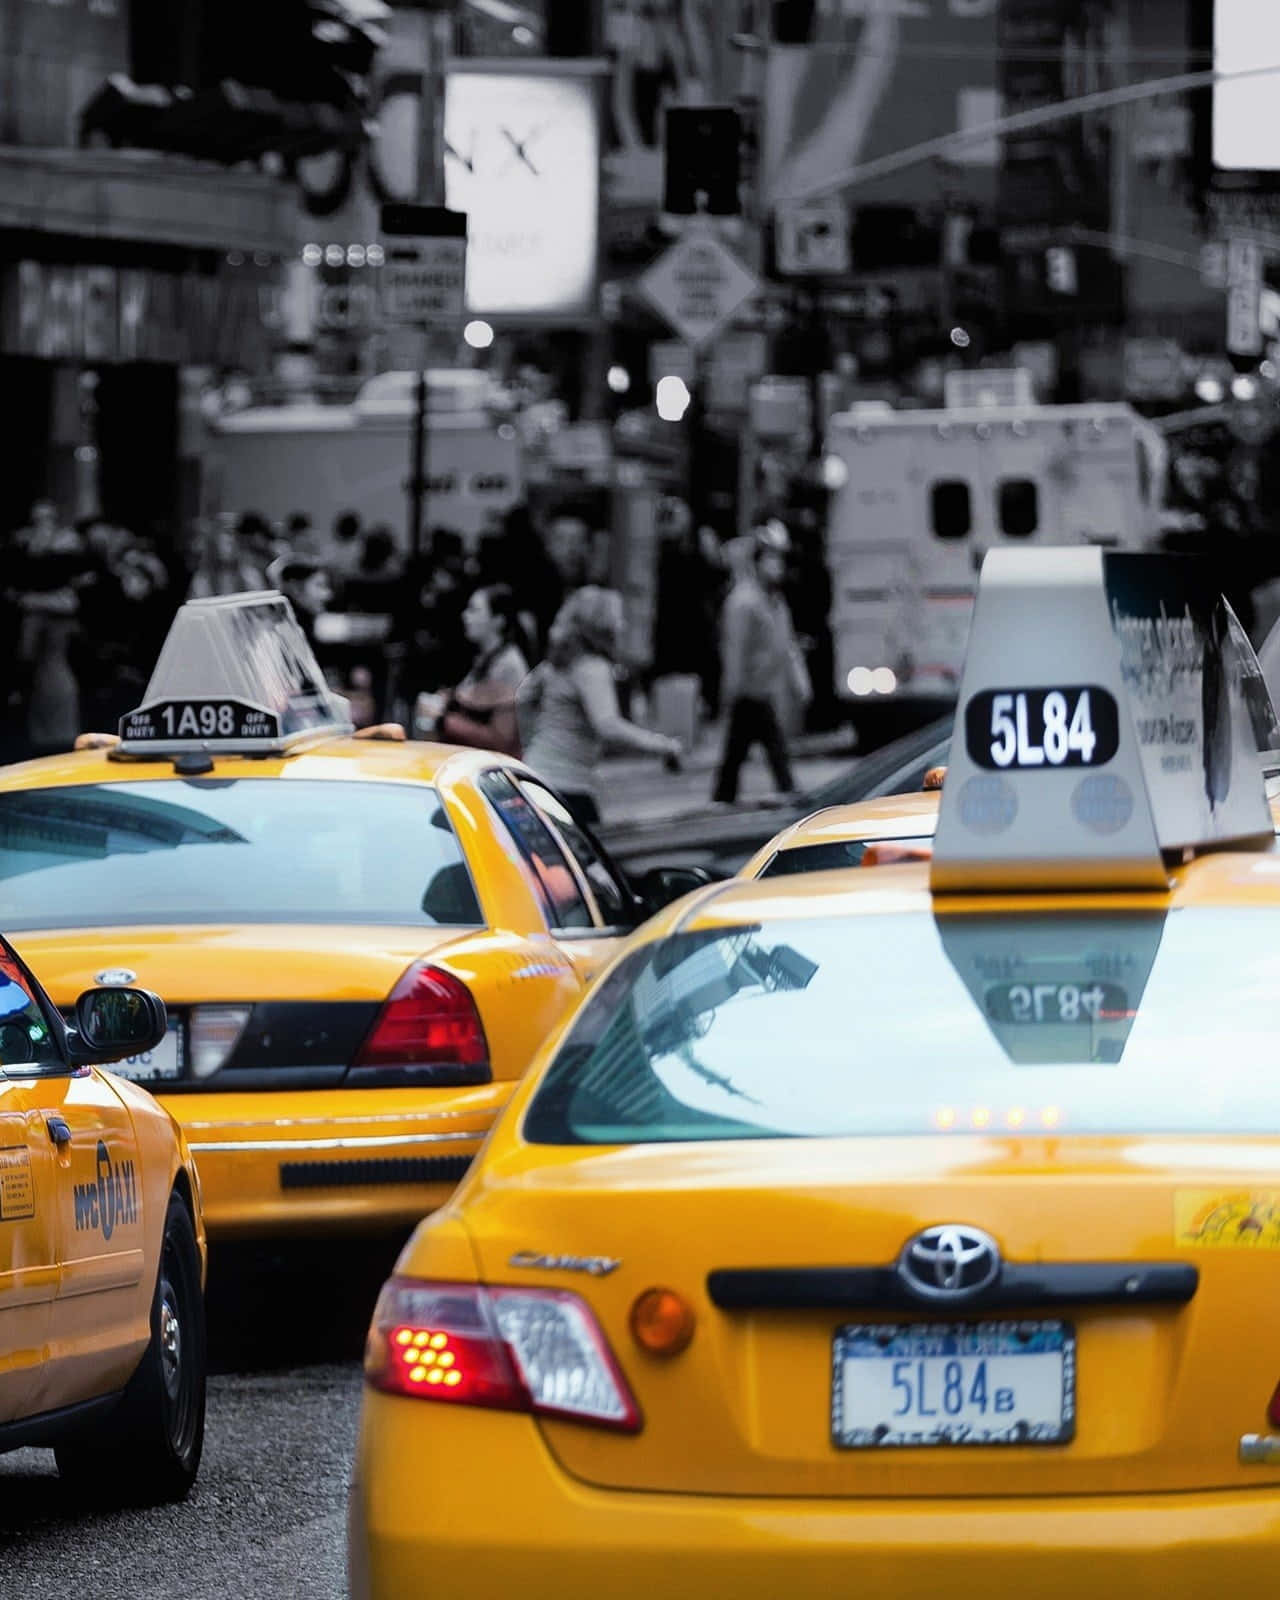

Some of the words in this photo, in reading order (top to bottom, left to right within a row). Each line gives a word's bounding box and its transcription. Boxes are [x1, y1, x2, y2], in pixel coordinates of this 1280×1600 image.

[131, 714, 151, 725] OFF
[161, 704, 235, 735] 1A98
[246, 713, 266, 723] OFF
[126, 727, 155, 737] DUTY
[241, 724, 269, 736] DUTY
[990, 690, 1097, 767] 5L84
[74, 1184, 98, 1230] NYC
[98, 1155, 137, 1230] TAXI
